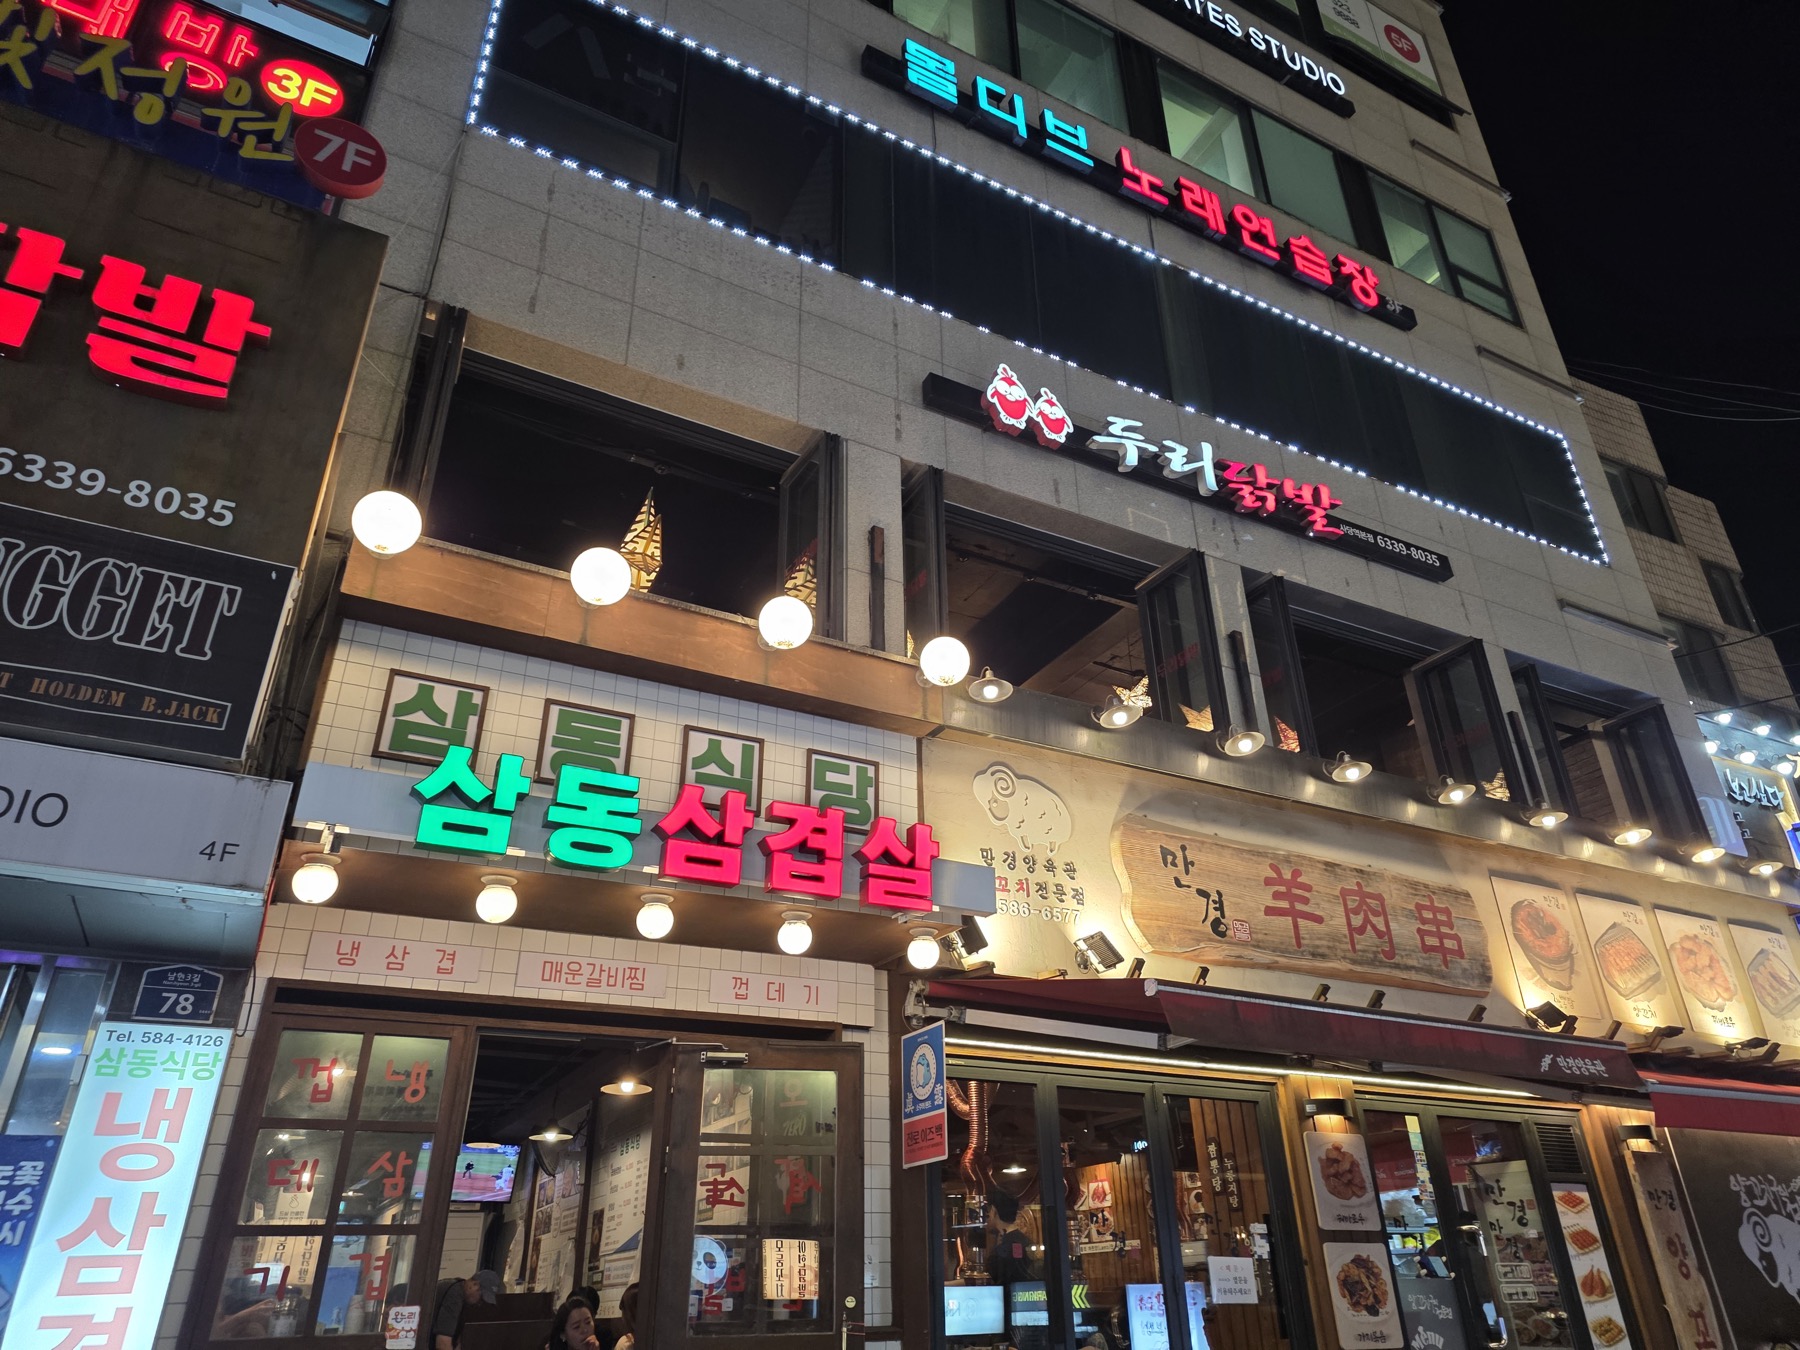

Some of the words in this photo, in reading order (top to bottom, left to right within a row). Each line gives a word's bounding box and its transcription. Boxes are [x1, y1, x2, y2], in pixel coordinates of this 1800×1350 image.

[1247, 27, 1346, 96] STUDIO
[0, 0, 295, 162] 정원
[312, 128, 377, 173] 7F
[266, 67, 338, 108] 3F
[903, 38, 1095, 168] 몰디브
[1116, 146, 1380, 308] 노래연습장
[1376, 535, 1441, 567] 6339-8035
[29, 678, 127, 708] HOLDEM
[141, 696, 223, 724] B.JACK
[198, 840, 241, 863] 4F
[998, 899, 1081, 924] 586-6577
[1263, 862, 1467, 970] 羊肉串
[541, 959, 647, 992] 매운갈비찜
[158, 991, 195, 1015] 78
[105, 1029, 136, 1043] Tel.
[140, 1031, 225, 1048] 584-4126
[93, 1046, 223, 1082] 삼동식당
[0, 1187, 34, 1216] 수
